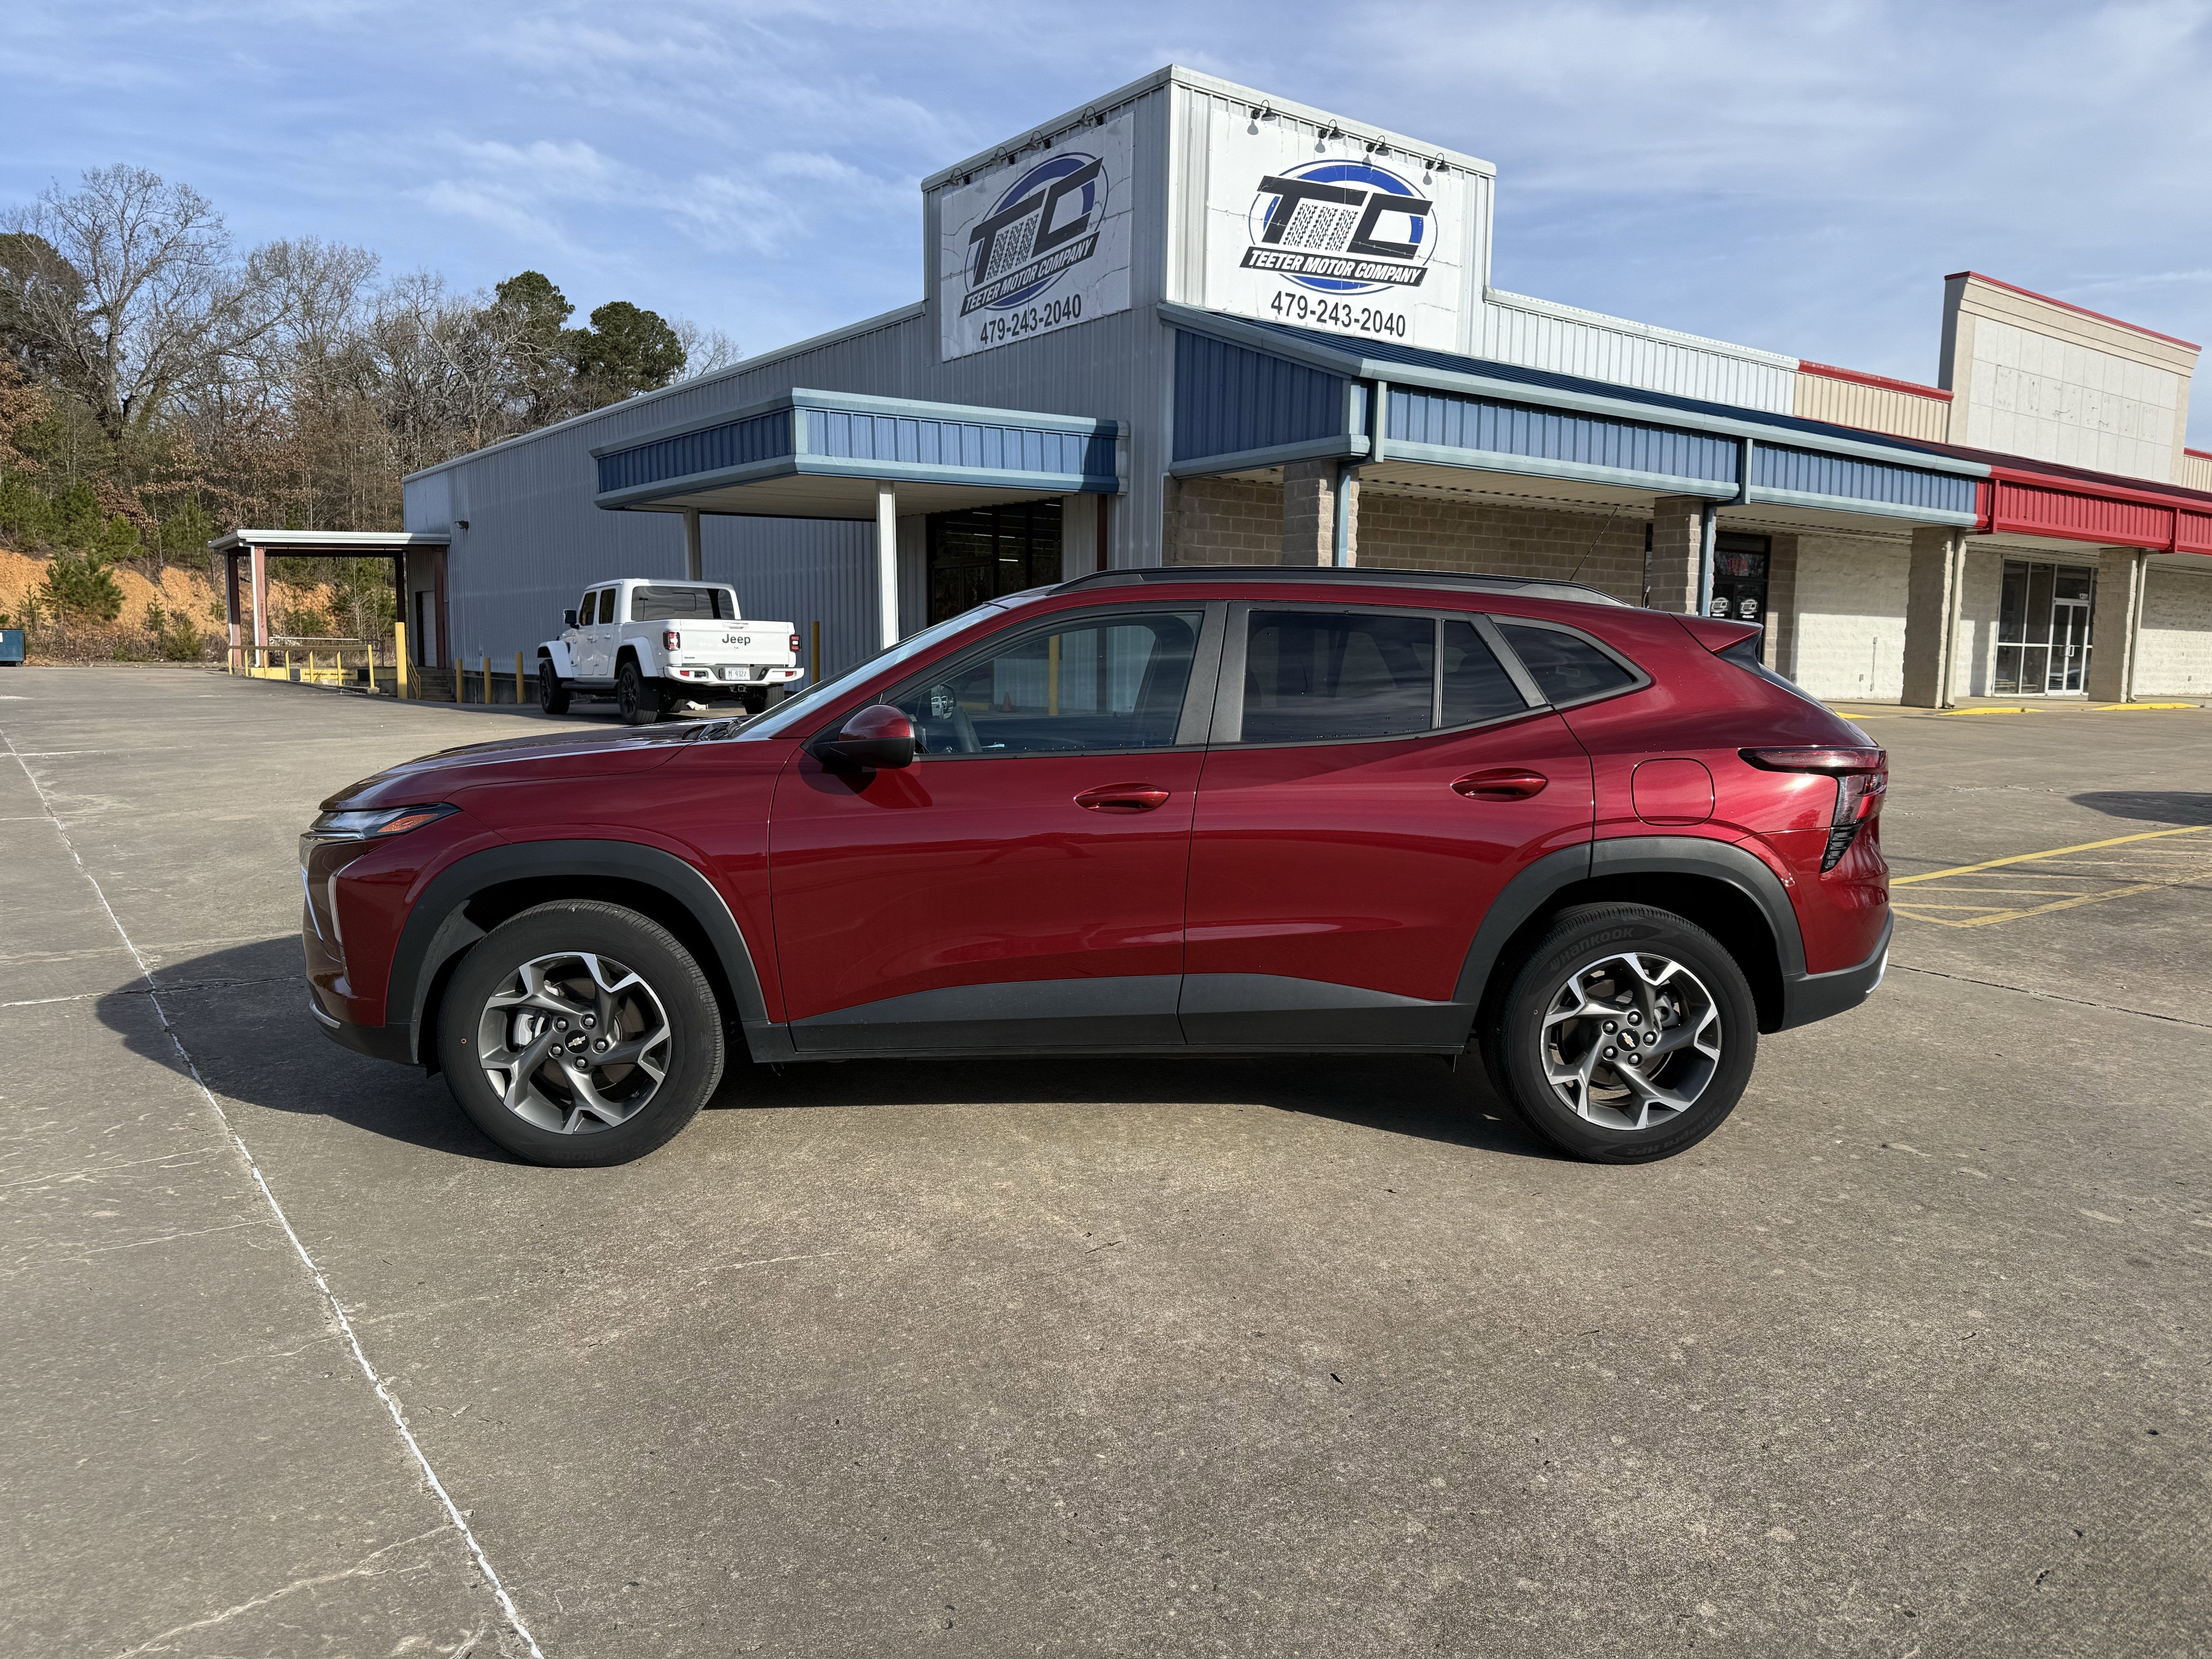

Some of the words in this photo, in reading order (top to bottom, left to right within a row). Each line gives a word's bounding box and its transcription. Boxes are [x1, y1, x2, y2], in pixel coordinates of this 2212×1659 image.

[965, 284, 1001, 312] TEETER
[1000, 264, 1038, 295] MOTOR
[1037, 237, 1094, 278] COMPANY
[1249, 250, 1302, 271] TEETER
[1304, 257, 1352, 276] MOTOR
[1354, 262, 1422, 283] COMPANY
[980, 294, 1082, 345] 479-243-2040
[1271, 290, 1406, 338] 479-243-2040
[722, 634, 750, 646] Jeep
